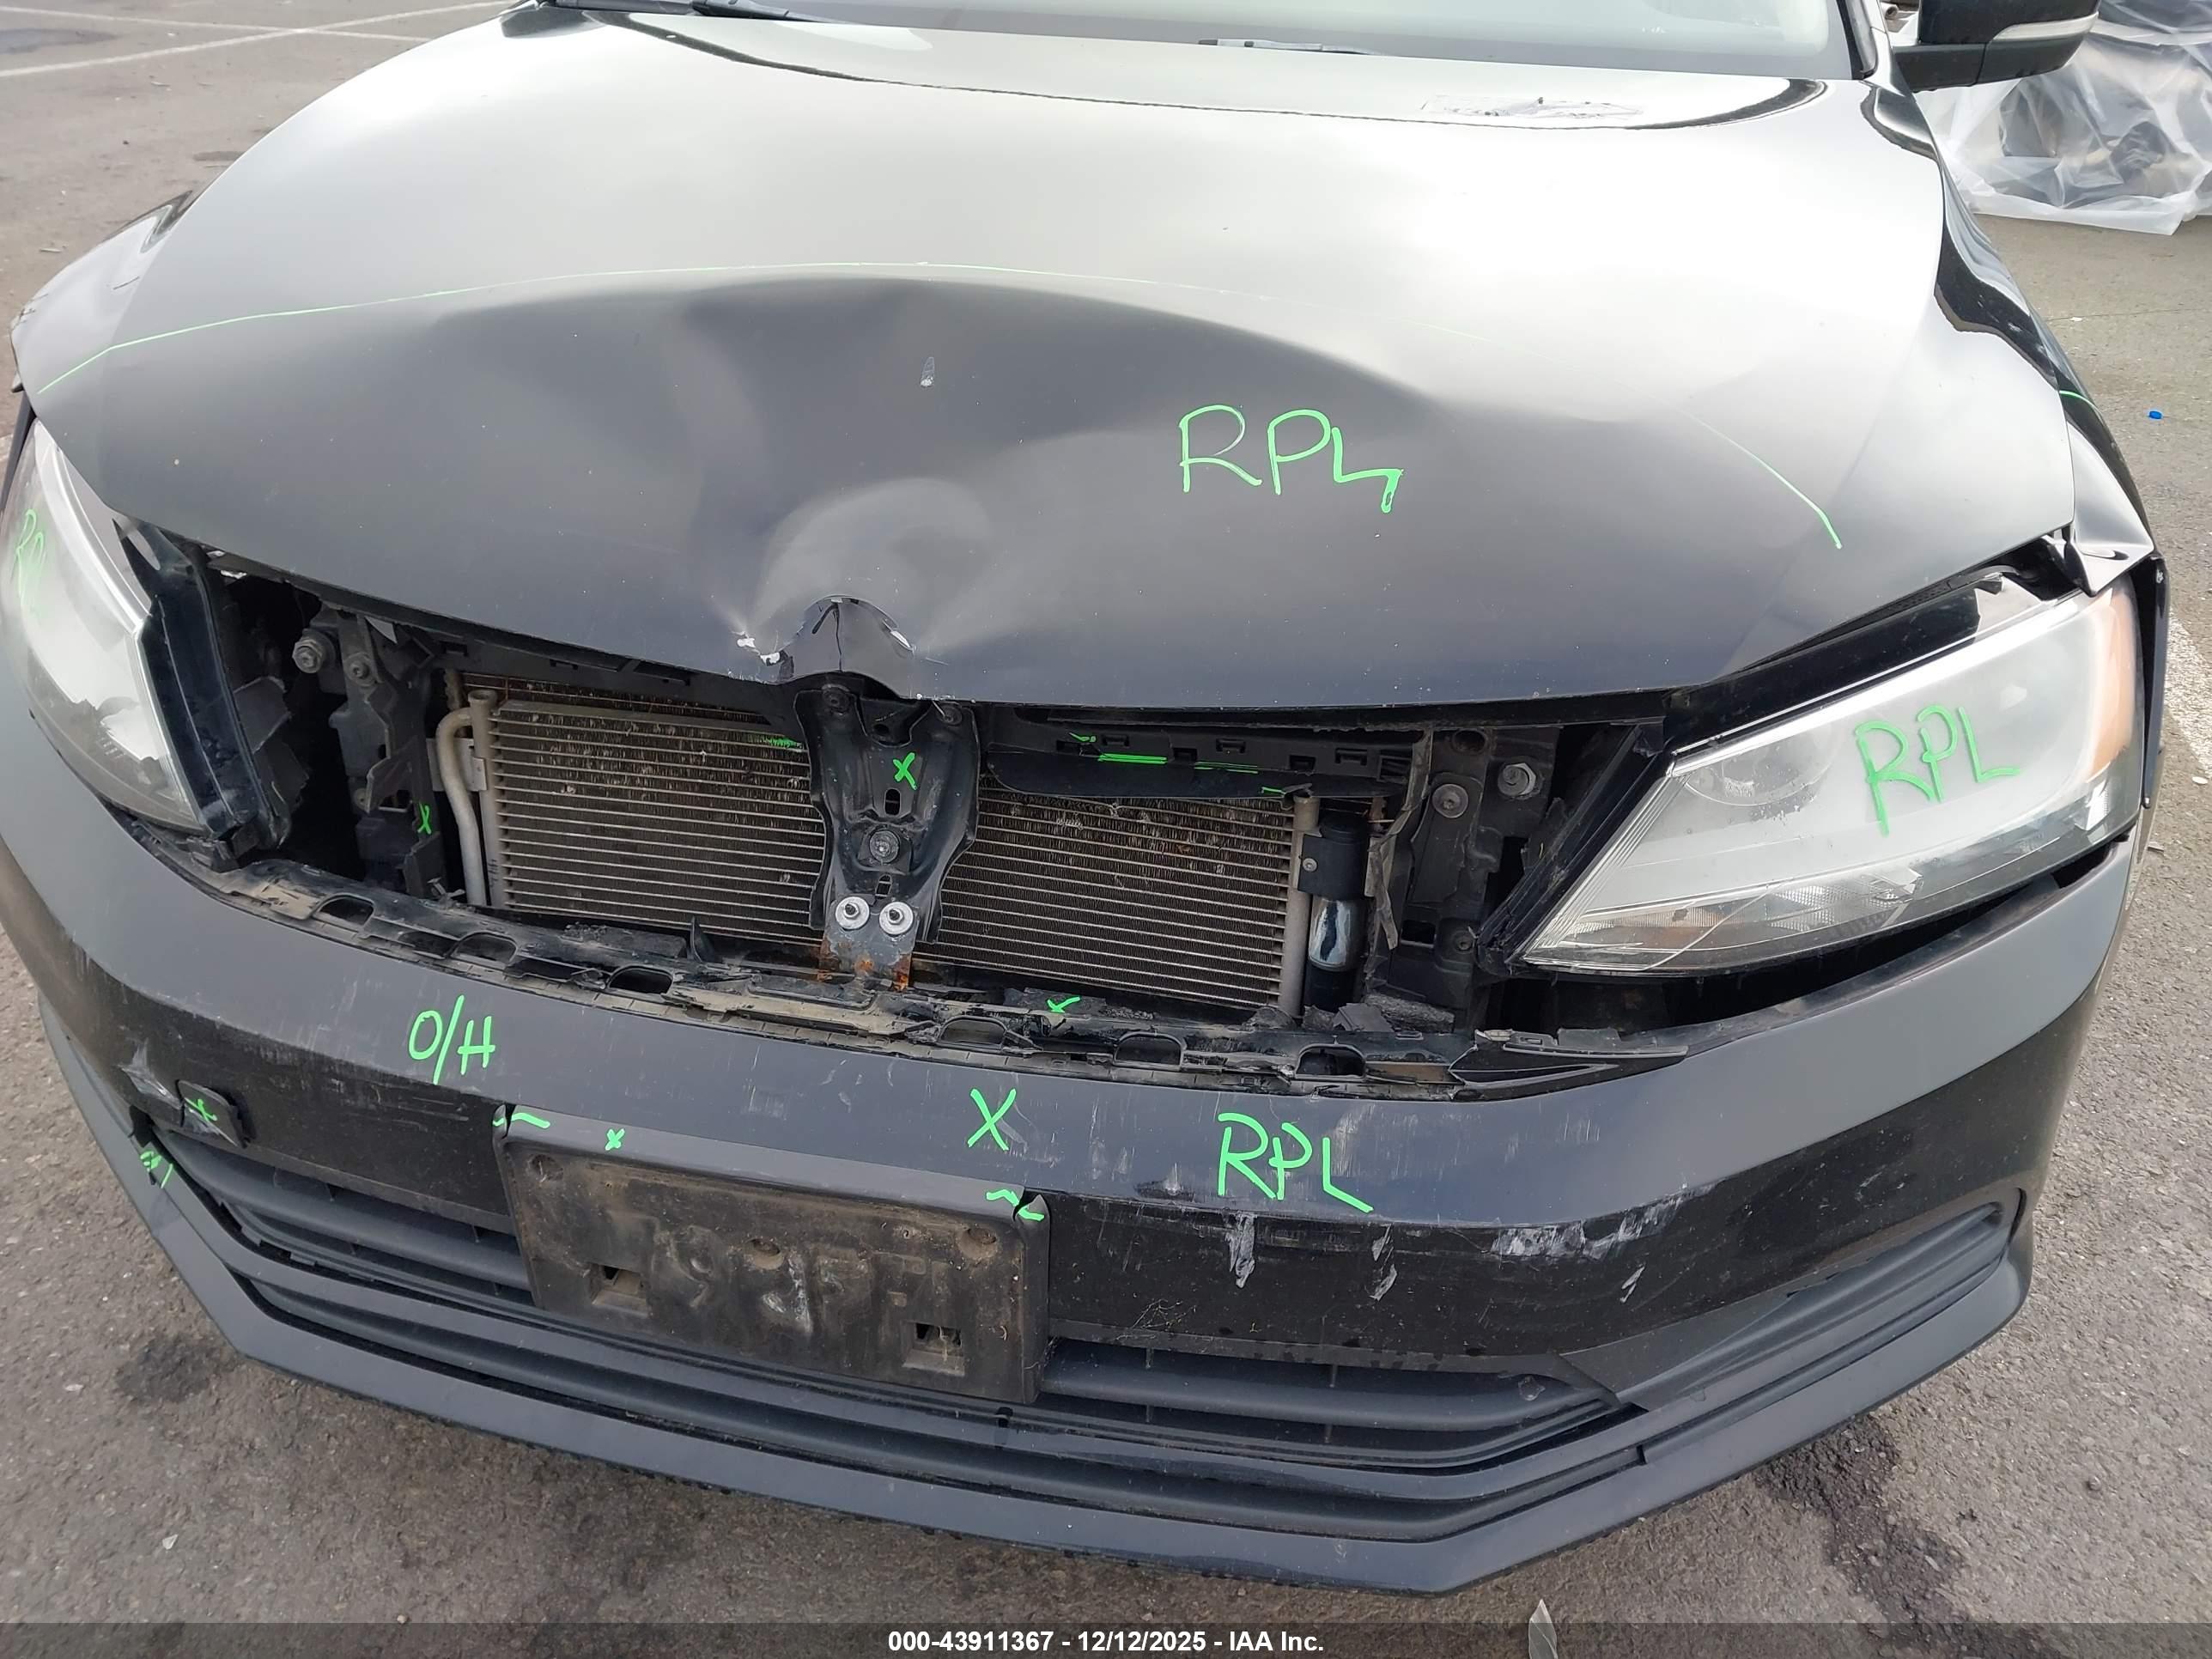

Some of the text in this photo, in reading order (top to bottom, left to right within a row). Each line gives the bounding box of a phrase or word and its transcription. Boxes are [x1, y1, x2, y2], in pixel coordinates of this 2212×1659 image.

[1854, 704, 2021, 837] RPL
[407, 994, 496, 1085] O/H
[1217, 1111, 1374, 1212] RPL
